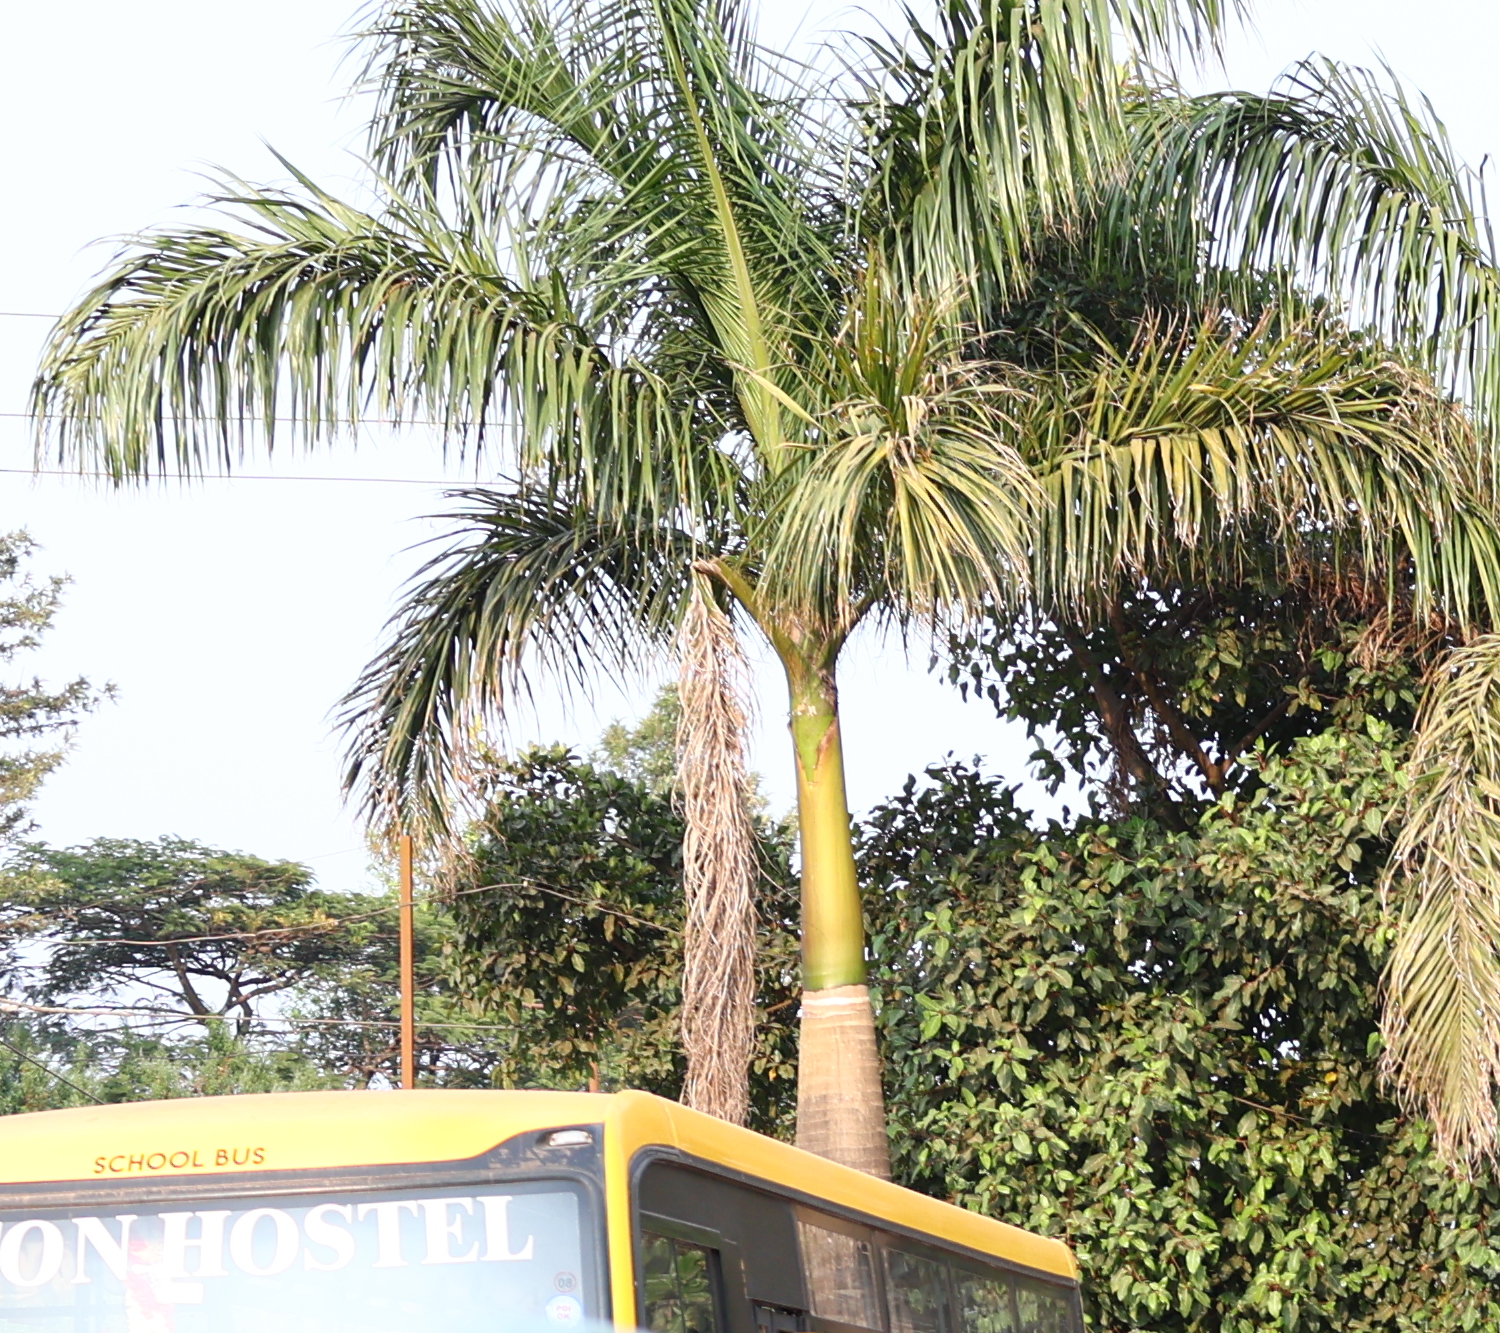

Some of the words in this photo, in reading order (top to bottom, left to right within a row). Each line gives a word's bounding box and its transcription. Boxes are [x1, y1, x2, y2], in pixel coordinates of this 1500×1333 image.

[94, 1150, 204, 1174] SCHOOL
[215, 1147, 266, 1167] BUS
[156, 1195, 534, 1278] HOSTEL
